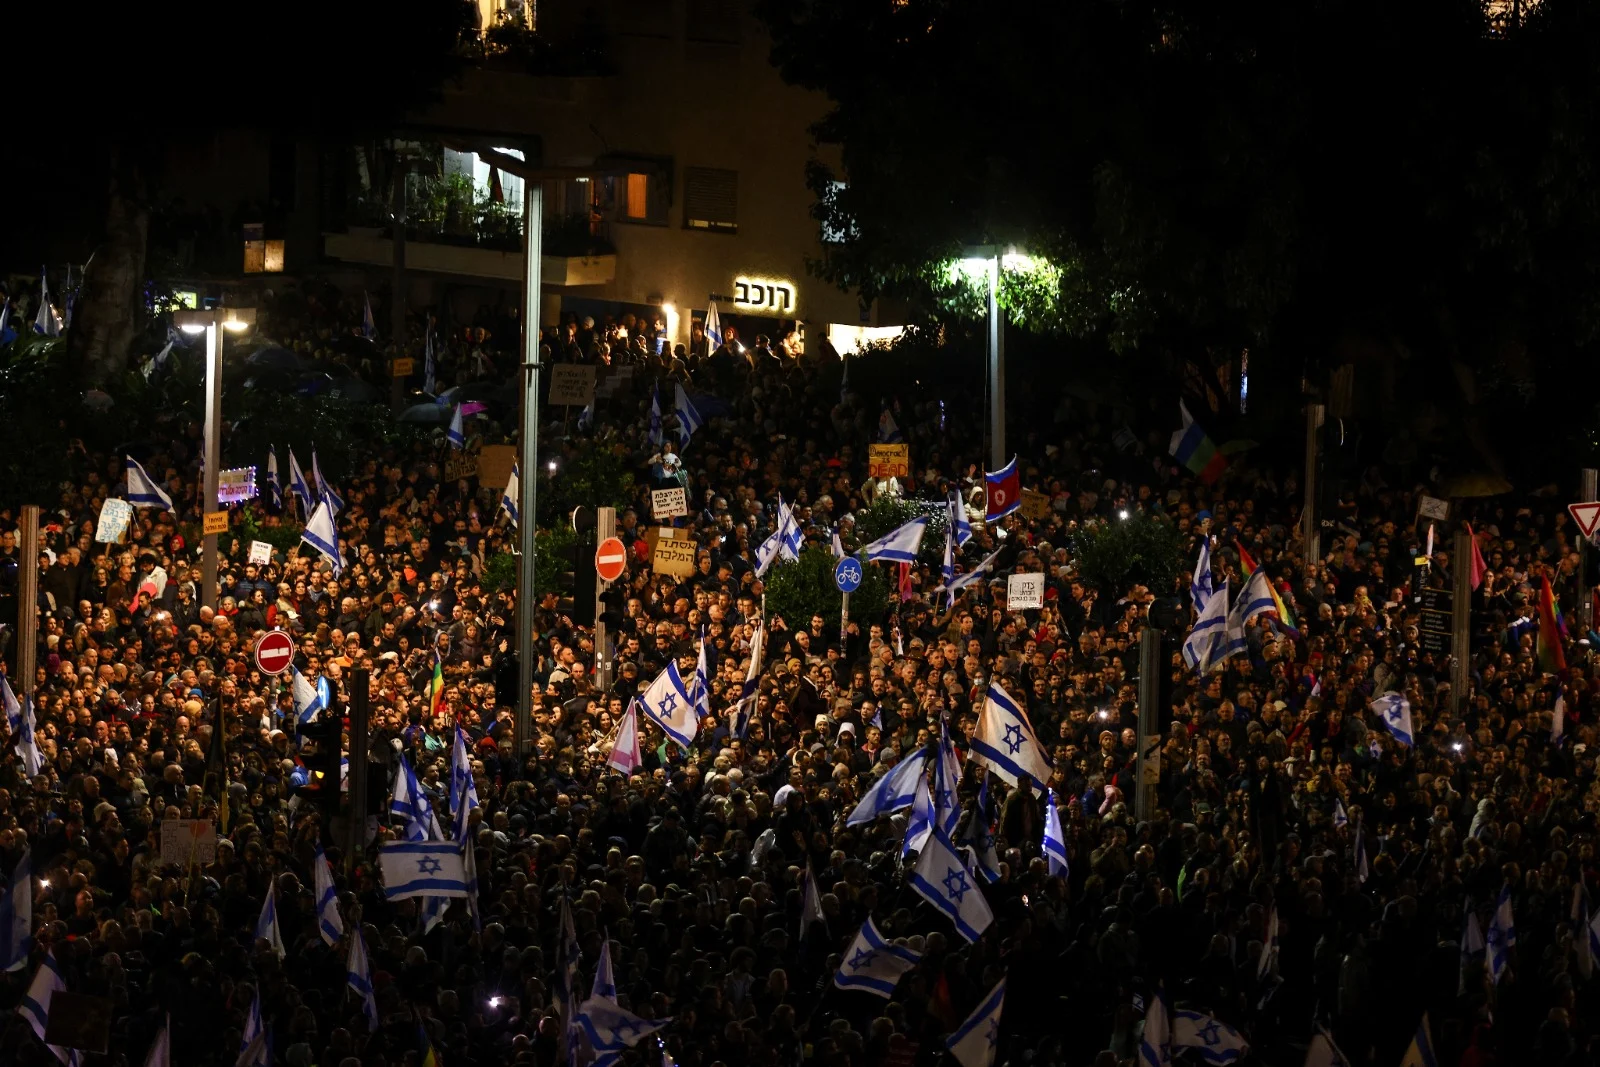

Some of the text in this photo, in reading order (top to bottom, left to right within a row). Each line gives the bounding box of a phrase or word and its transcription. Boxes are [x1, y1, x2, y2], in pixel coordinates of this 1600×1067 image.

[735, 281, 791, 309] רוכב
[869, 463, 908, 478] DEAD
[660, 539, 696, 550] אסתר
[1021, 581, 1035, 591] צדק
